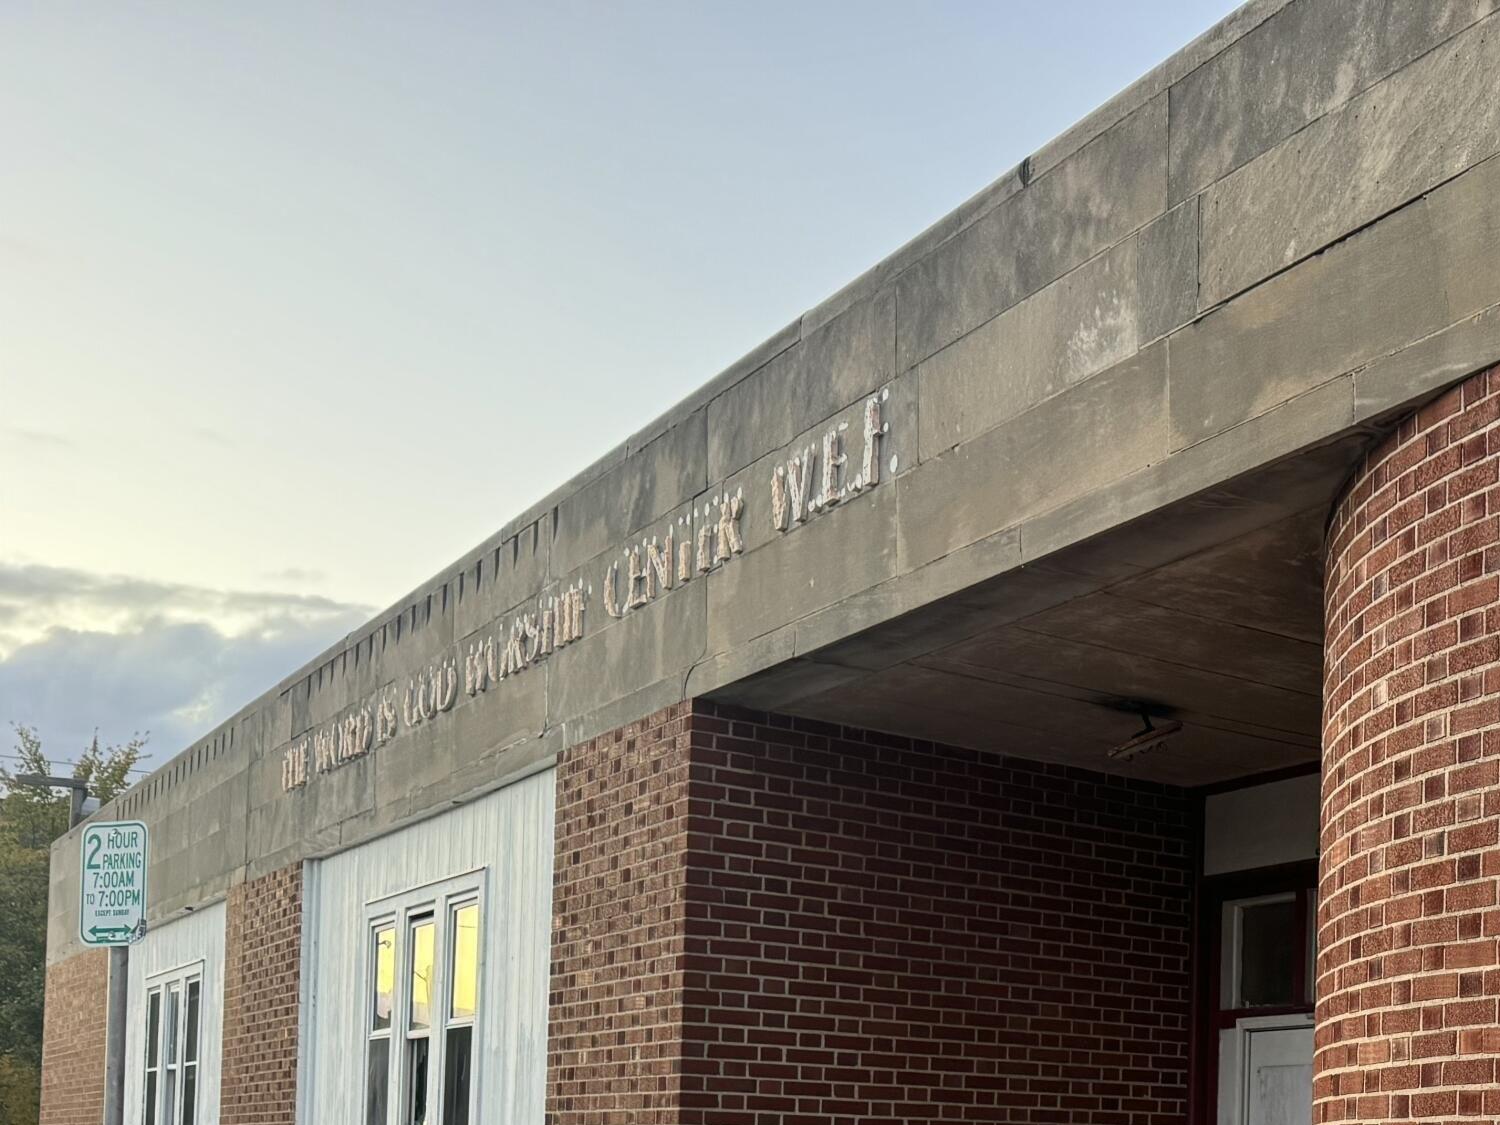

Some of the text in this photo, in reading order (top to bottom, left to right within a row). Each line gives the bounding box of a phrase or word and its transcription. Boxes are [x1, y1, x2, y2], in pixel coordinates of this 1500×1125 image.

[87, 831, 138, 870] 2 HOUR
[102, 852, 142, 870] PARKING
[92, 870, 135, 889] 7:00AM
[86, 889, 141, 907] TO 7:00PM
